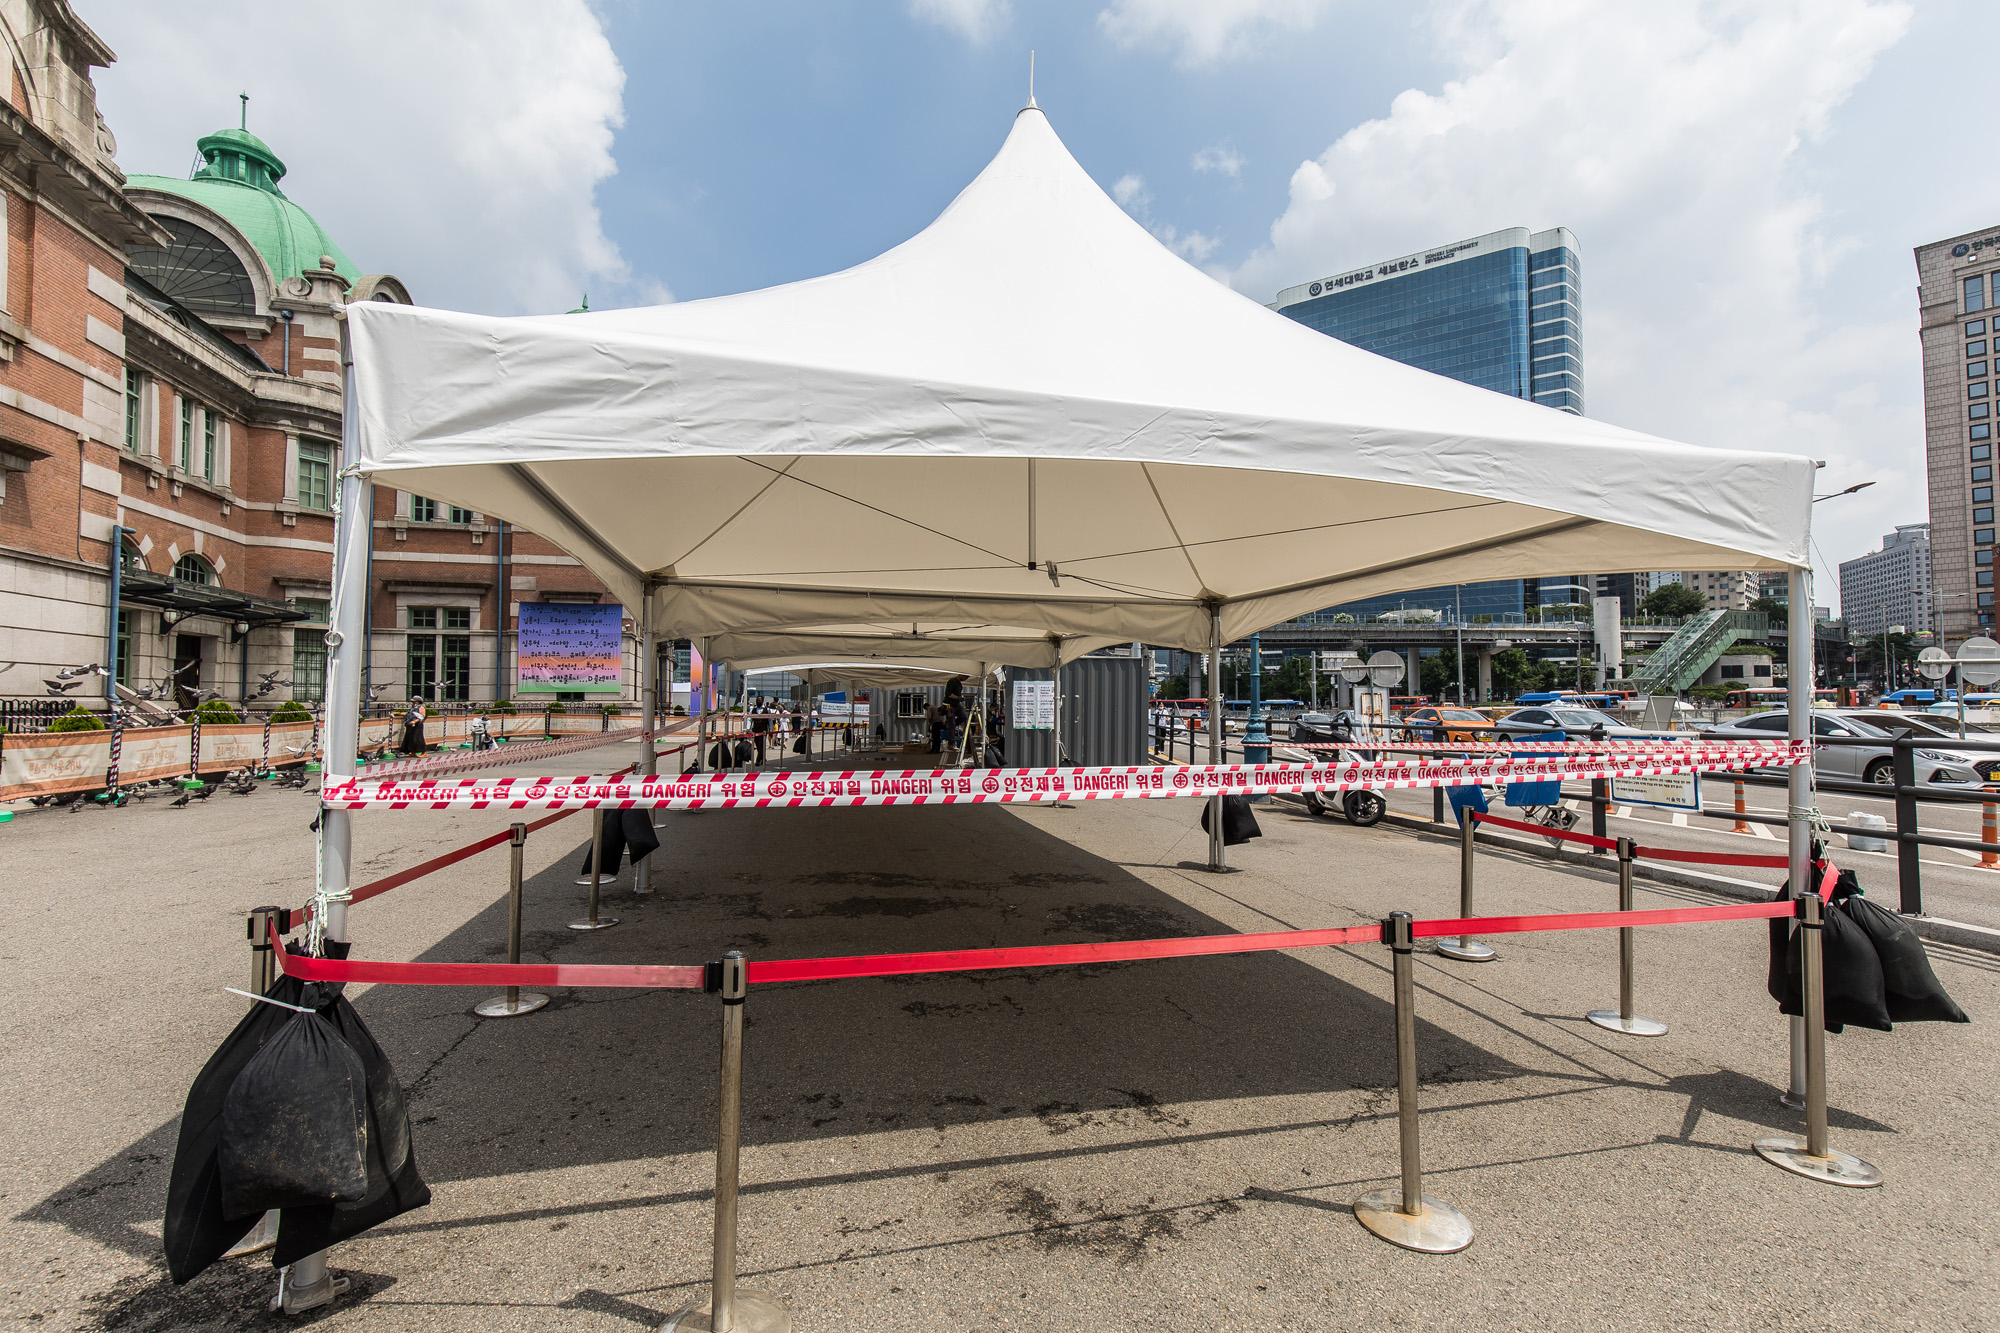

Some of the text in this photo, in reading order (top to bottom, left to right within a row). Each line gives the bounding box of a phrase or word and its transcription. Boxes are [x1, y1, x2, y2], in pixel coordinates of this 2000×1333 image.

[1446, 241, 1479, 254] UNIVERSITY
[1325, 258, 1419, 291] 연세대학교 세브란스
[375, 787, 460, 801] DANGER!
[470, 786, 511, 801] 위험
[553, 784, 631, 800] 안전제일
[641, 783, 712, 799] DANGER!
[721, 781, 756, 798] 위험
[792, 779, 862, 798] 안전제일
[871, 778, 933, 797] DANGER!
[940, 777, 972, 795] 위험
[1003, 775, 1066, 793] 안전제일
[1073, 773, 1129, 792] DANGER!
[1135, 772, 1164, 790] 위험
[1192, 771, 1249, 788] 안전제일
[1255, 770, 1305, 786] DANGER!
[1311, 769, 1337, 785] 위험
[1362, 767, 1412, 783] 안전제일
[1417, 765, 1464, 780] DANGER!
[1467, 764, 1492, 778] 위험
